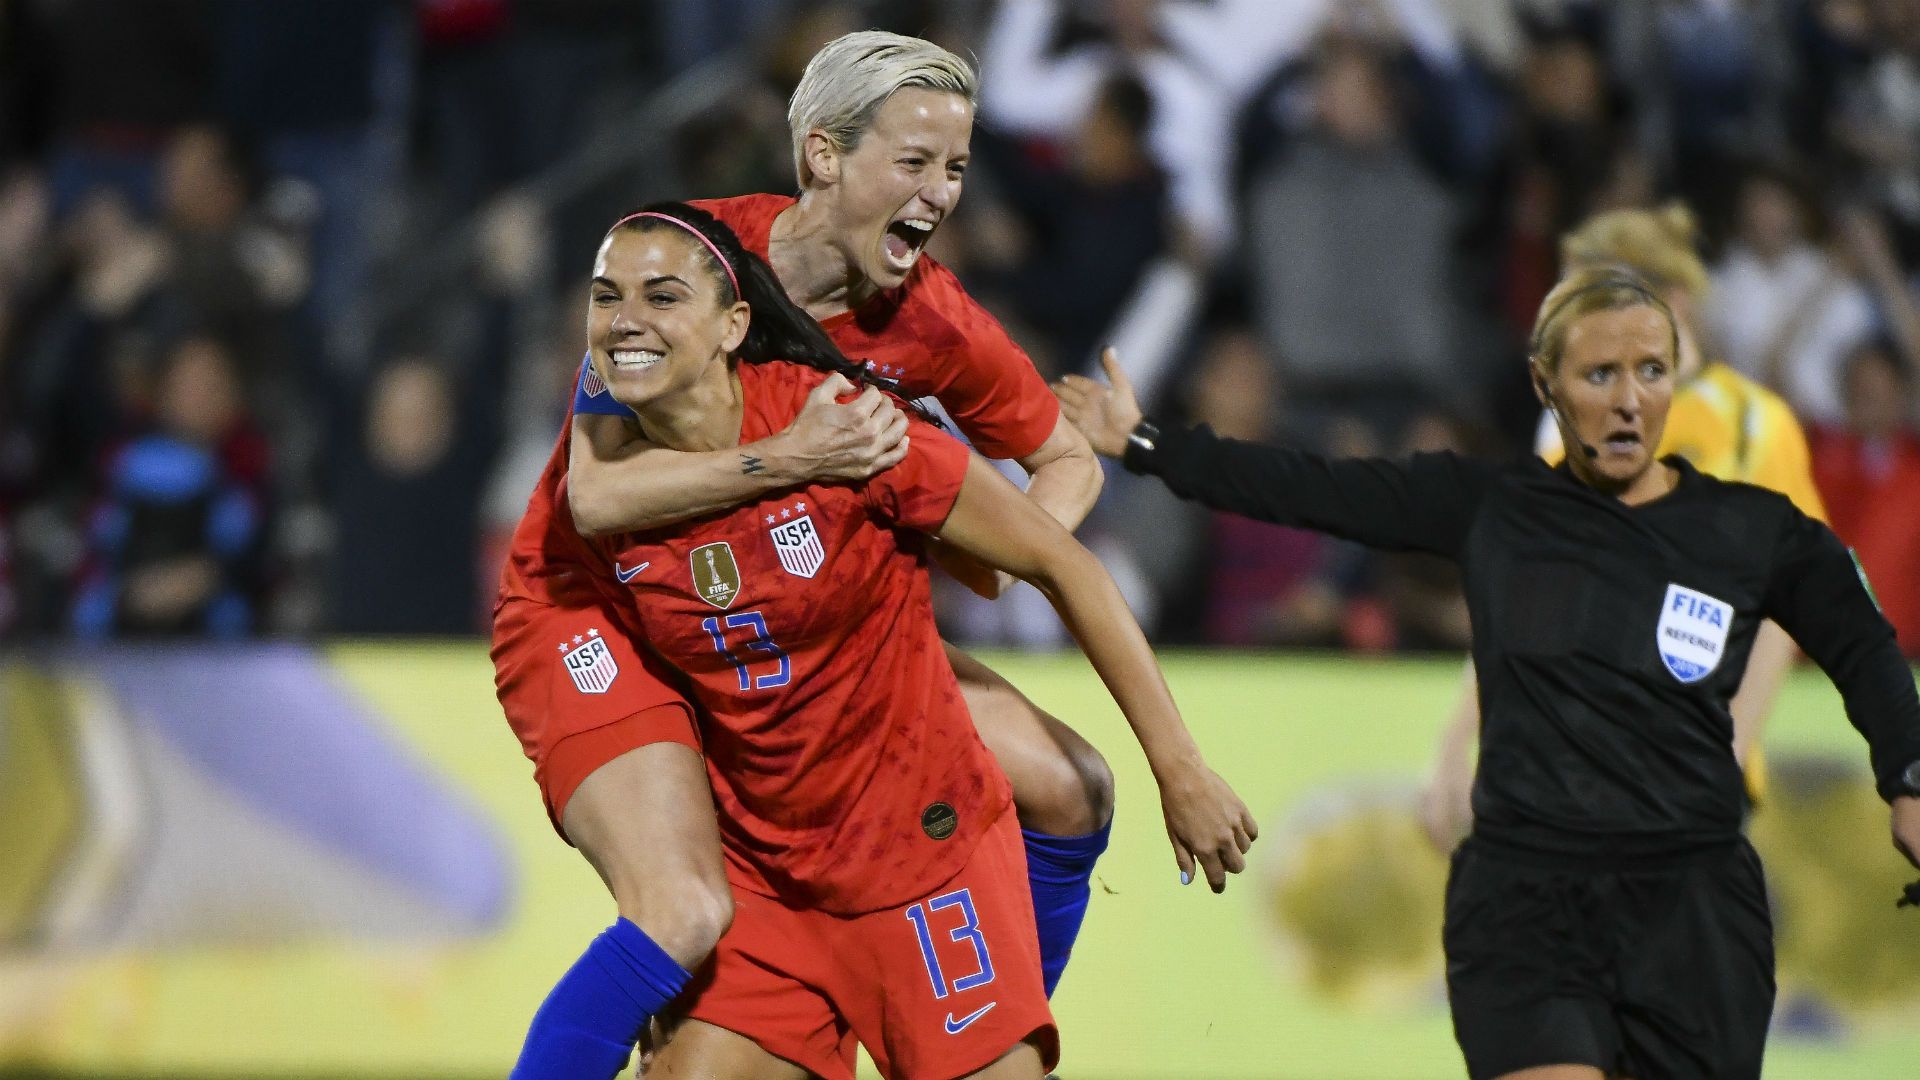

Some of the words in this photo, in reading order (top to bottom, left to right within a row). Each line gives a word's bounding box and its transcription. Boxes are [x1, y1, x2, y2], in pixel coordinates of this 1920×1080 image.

[774, 519, 812, 547] USA
[708, 582, 730, 594] FIFA
[1672, 592, 1723, 629] FIFA
[702, 611, 791, 691] 13
[1664, 626, 1719, 653] REFEREE
[567, 641, 605, 670] USA
[905, 888, 996, 1000] 13
